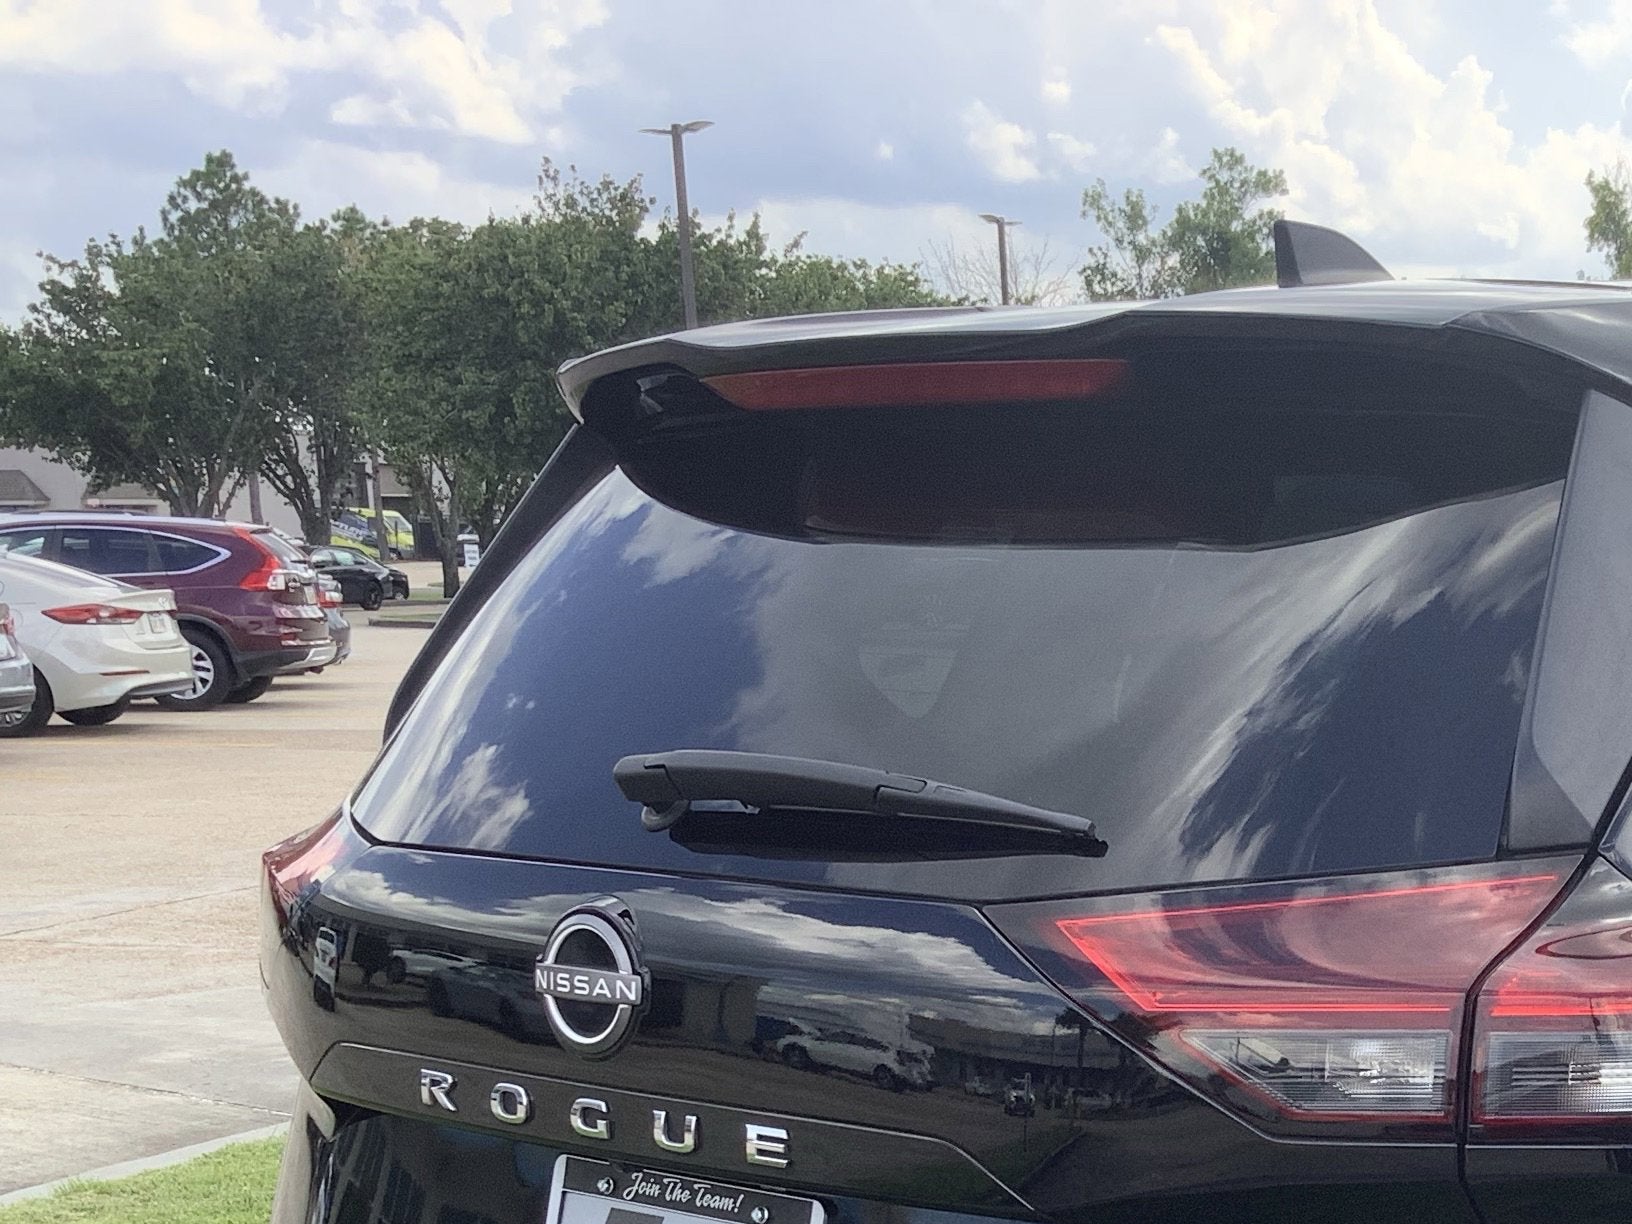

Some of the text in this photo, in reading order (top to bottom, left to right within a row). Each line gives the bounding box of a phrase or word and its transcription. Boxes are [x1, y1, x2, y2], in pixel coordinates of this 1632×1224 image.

[535, 968, 637, 1001] NISSAN
[420, 1068, 791, 1168] ROGUE
[623, 1172, 744, 1213] Join The Team!
